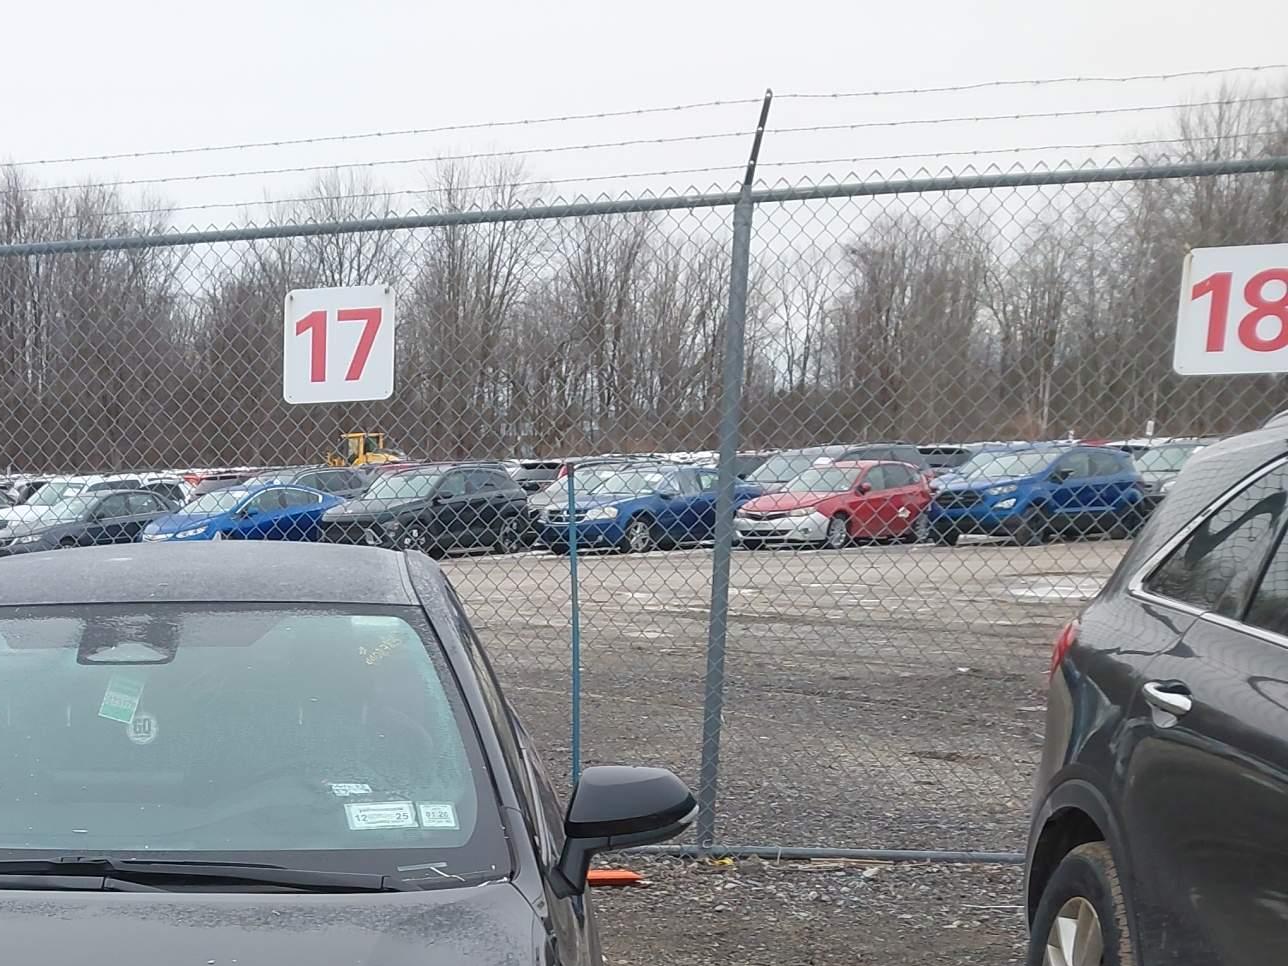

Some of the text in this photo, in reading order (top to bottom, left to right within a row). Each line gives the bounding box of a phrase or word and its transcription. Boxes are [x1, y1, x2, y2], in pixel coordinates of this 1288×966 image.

[295, 307, 382, 383] 17
[1190, 267, 1288, 352] 18
[394, 812, 410, 821] 25
